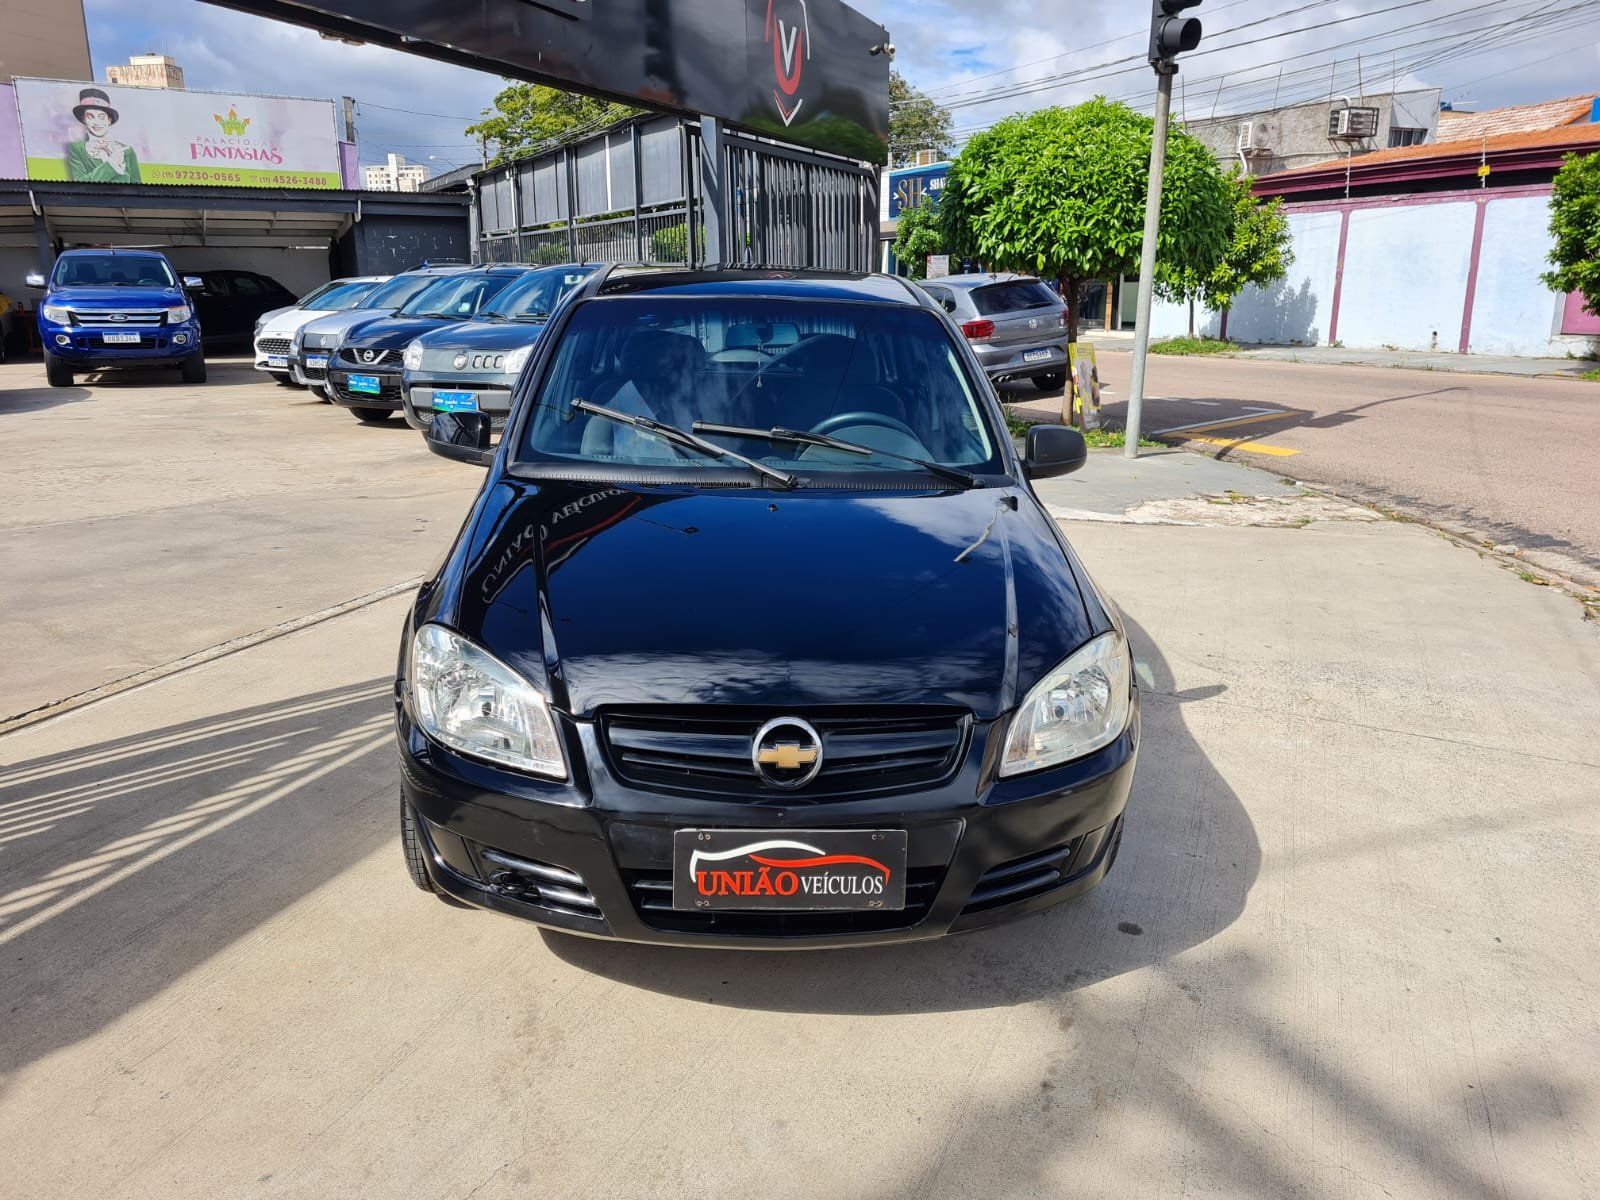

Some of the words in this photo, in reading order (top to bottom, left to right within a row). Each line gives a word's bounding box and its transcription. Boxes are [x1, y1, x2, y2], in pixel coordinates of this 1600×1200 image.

[190, 143, 284, 165] FANTASIAS
[175, 170, 241, 182] 97230-0565
[272, 175, 328, 186] 4526-3488
[896, 176, 924, 210] SH
[696, 867, 799, 896] UNIÃO
[800, 871, 884, 896] VEÍCULOS
